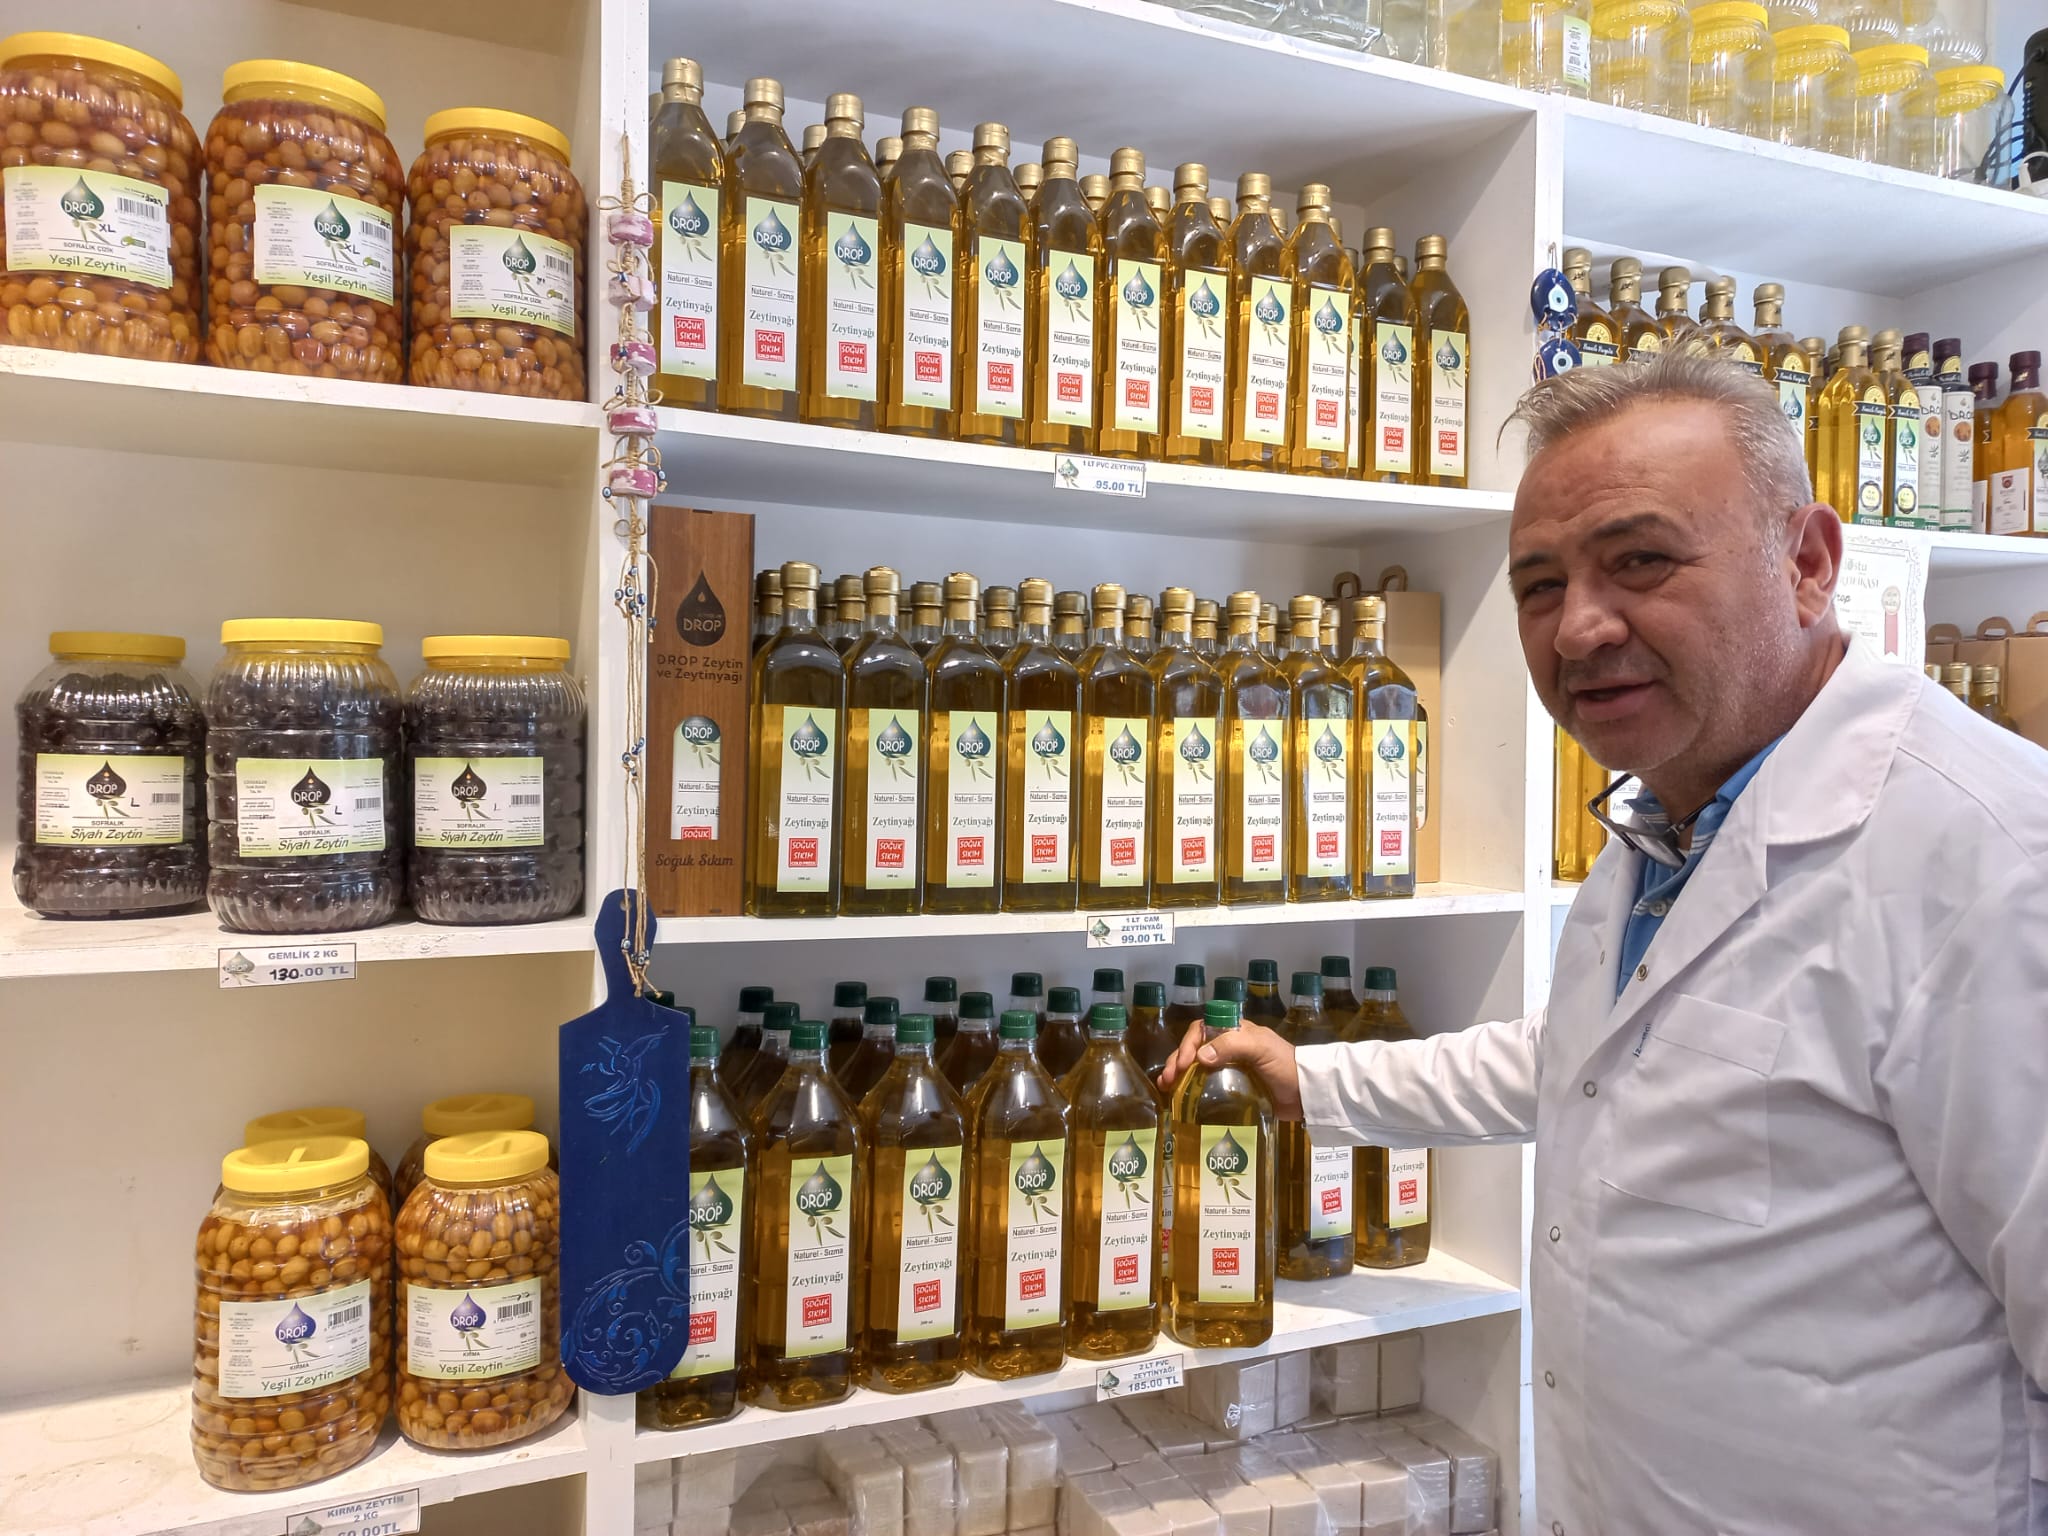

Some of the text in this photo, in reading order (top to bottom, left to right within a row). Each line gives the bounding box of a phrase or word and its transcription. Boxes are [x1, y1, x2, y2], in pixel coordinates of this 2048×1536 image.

[64, 200, 95, 214] DROP
[99, 224, 116, 233] XL
[317, 222, 343, 234] DROP
[672, 216, 700, 232] DROP
[756, 232, 783, 246] DROP
[344, 242, 360, 254] XL
[838, 246, 864, 260] DROP
[50, 254, 126, 272] Yeşil Zeytin
[506, 256, 529, 269] DROP
[914, 257, 938, 270] DROP
[304, 272, 367, 291] Yeşil Zeytin
[667, 274, 690, 284] Naturel
[988, 270, 1011, 282] DROP
[1058, 282, 1080, 295] DROP
[1126, 290, 1148, 303] DROP
[666, 296, 712, 314] Zeytinyağı
[1192, 300, 1214, 312] DROP
[492, 304, 550, 321] Yeşil Zeytin
[750, 309, 794, 326] Zeytinyağı
[1258, 308, 1278, 320] DROP
[676, 320, 702, 330] SOĞUK
[1316, 318, 1336, 330] DROP
[832, 323, 874, 338] Zeytinyağı
[758, 334, 782, 343] SOĞUK
[908, 332, 949, 348] Zeytinyağı
[982, 342, 1022, 358] Zeytinyağı
[1384, 350, 1402, 360] DROP
[1052, 354, 1090, 368] Zeytinyağı
[1438, 356, 1456, 366] DROP
[1120, 361, 1157, 374] Zeytinyağı
[1186, 369, 1222, 383] Zeytinyağı
[1250, 376, 1284, 388] Zeytinyağı
[1312, 384, 1344, 398] Zeytinyağı
[1096, 480, 1140, 492] 95.00 TL
[683, 618, 722, 632] DROP
[656, 654, 743, 671] DROP Zeytin
[657, 668, 742, 684] ve Zeytinyağı
[685, 726, 712, 739] DROP
[793, 739, 819, 751] DROP
[879, 740, 904, 752] DROP
[959, 741, 984, 753] DROP
[1035, 741, 1058, 752] DROP
[1380, 746, 1399, 756] DROP
[1112, 748, 1134, 759] DROP
[1183, 747, 1204, 758] DROP
[1252, 748, 1272, 758] DROP
[1316, 746, 1336, 757] DROP
[88, 784, 118, 794] DROP
[454, 786, 478, 796] DROP
[130, 797, 140, 807] L
[294, 790, 322, 802] DROP
[335, 806, 342, 815] L
[784, 817, 829, 829] Zeytinyağı
[872, 816, 915, 828] Zeytinyağı
[953, 817, 993, 827] Zeytinyağı
[1028, 814, 1067, 825] Zeytinyağı
[1106, 819, 1143, 829] Zeytinyağı
[1177, 816, 1213, 826] Zeytinyağı
[70, 828, 142, 841] Siyah Zeytin
[440, 831, 503, 844] Siyah Zeytin
[683, 829, 710, 838] SOĞUK
[278, 838, 348, 853] Siyah Zeytin
[656, 854, 694, 872] Soğuk
[1122, 934, 1165, 943] 99.00 TL
[268, 950, 310, 960] GEMLİK
[323, 950, 338, 958] KG
[269, 966, 349, 980] 130.00 TL
[1112, 1160, 1139, 1175] DROP
[1209, 1157, 1239, 1170] DROP
[1018, 1172, 1047, 1189] DROP
[913, 1181, 942, 1198] DROP
[800, 1192, 832, 1209] DROP
[689, 1206, 722, 1224] DROP
[1106, 1211, 1148, 1221] Naturel Sızma
[1013, 1225, 1056, 1236] Naturel Sızma
[1203, 1229, 1250, 1240] Zeytinyağı
[906, 1235, 952, 1246] Naturel Sızma
[1104, 1234, 1148, 1248] Zeytinyağı
[794, 1248, 843, 1260] Naturel Sızma
[1011, 1248, 1057, 1262] Zeytinyağı
[1214, 1251, 1237, 1259] SOĞUK
[712, 1264, 733, 1272] Sızma
[904, 1259, 952, 1274] Zeytinyağı
[1116, 1259, 1136, 1268] SOĞUK
[792, 1271, 844, 1287] Zeytinyağı
[1022, 1274, 1044, 1283] SOĞUK
[916, 1284, 938, 1294] SOĞUK
[805, 1298, 829, 1309] SOĞUK
[453, 1315, 478, 1326] DROP
[278, 1324, 308, 1340] DROP
[440, 1362, 503, 1376] Yeşil Zeytin
[261, 1370, 334, 1392] Yeşil Zeytin
[1128, 1376, 1178, 1392] 185.00 TL
[328, 1504, 362, 1518] KIRMA
[363, 1511, 378, 1520] KG
